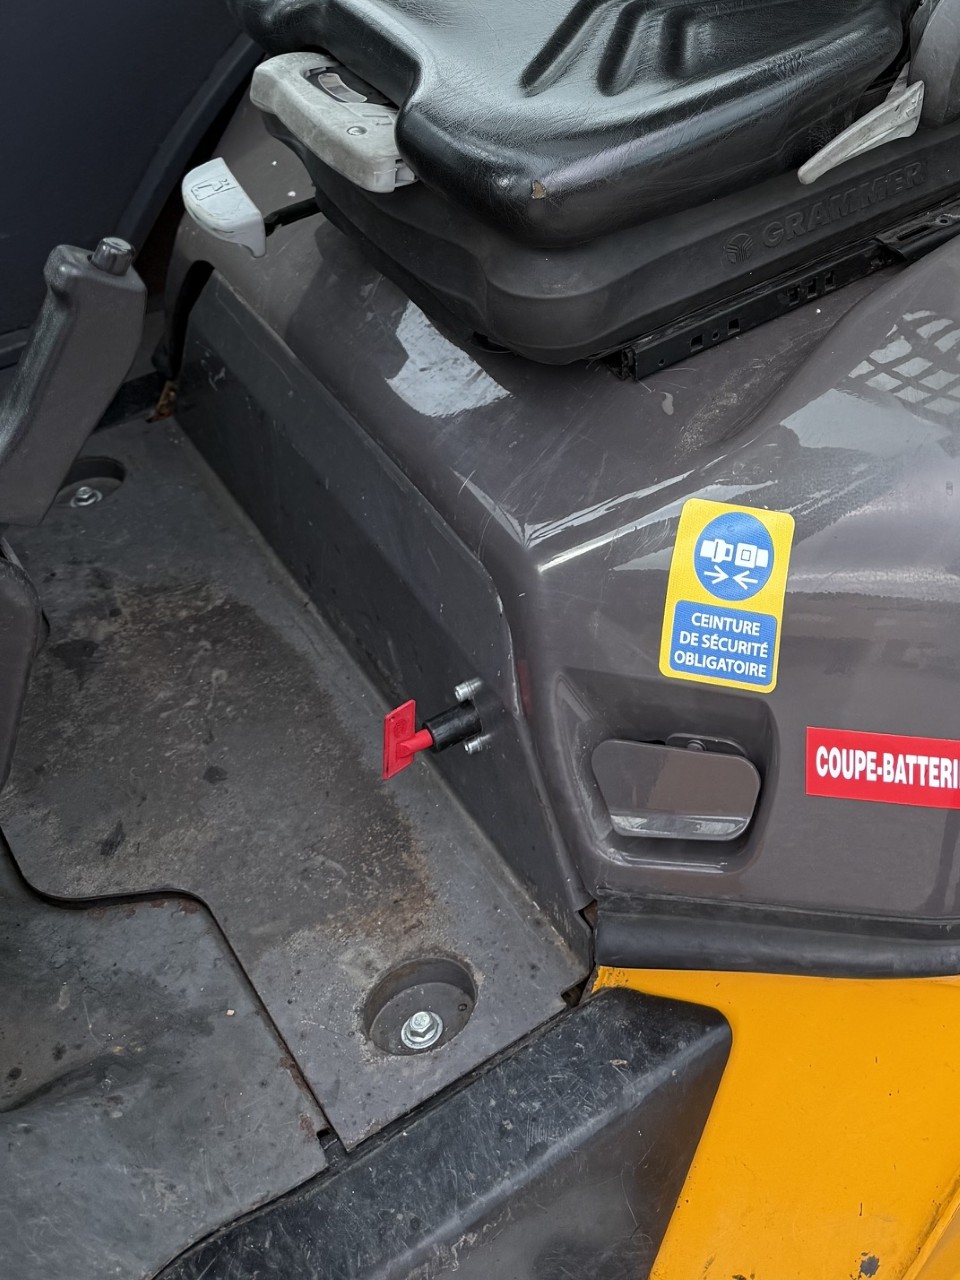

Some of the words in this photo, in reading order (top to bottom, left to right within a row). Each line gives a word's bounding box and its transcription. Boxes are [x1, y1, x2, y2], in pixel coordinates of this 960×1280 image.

[762, 162, 927, 248] GRAMMER
[691, 612, 761, 636] CEINTURE
[679, 631, 699, 646] DE
[701, 633, 769, 658] SÉCURITÉ
[674, 650, 767, 678] OBLIGATOIRE
